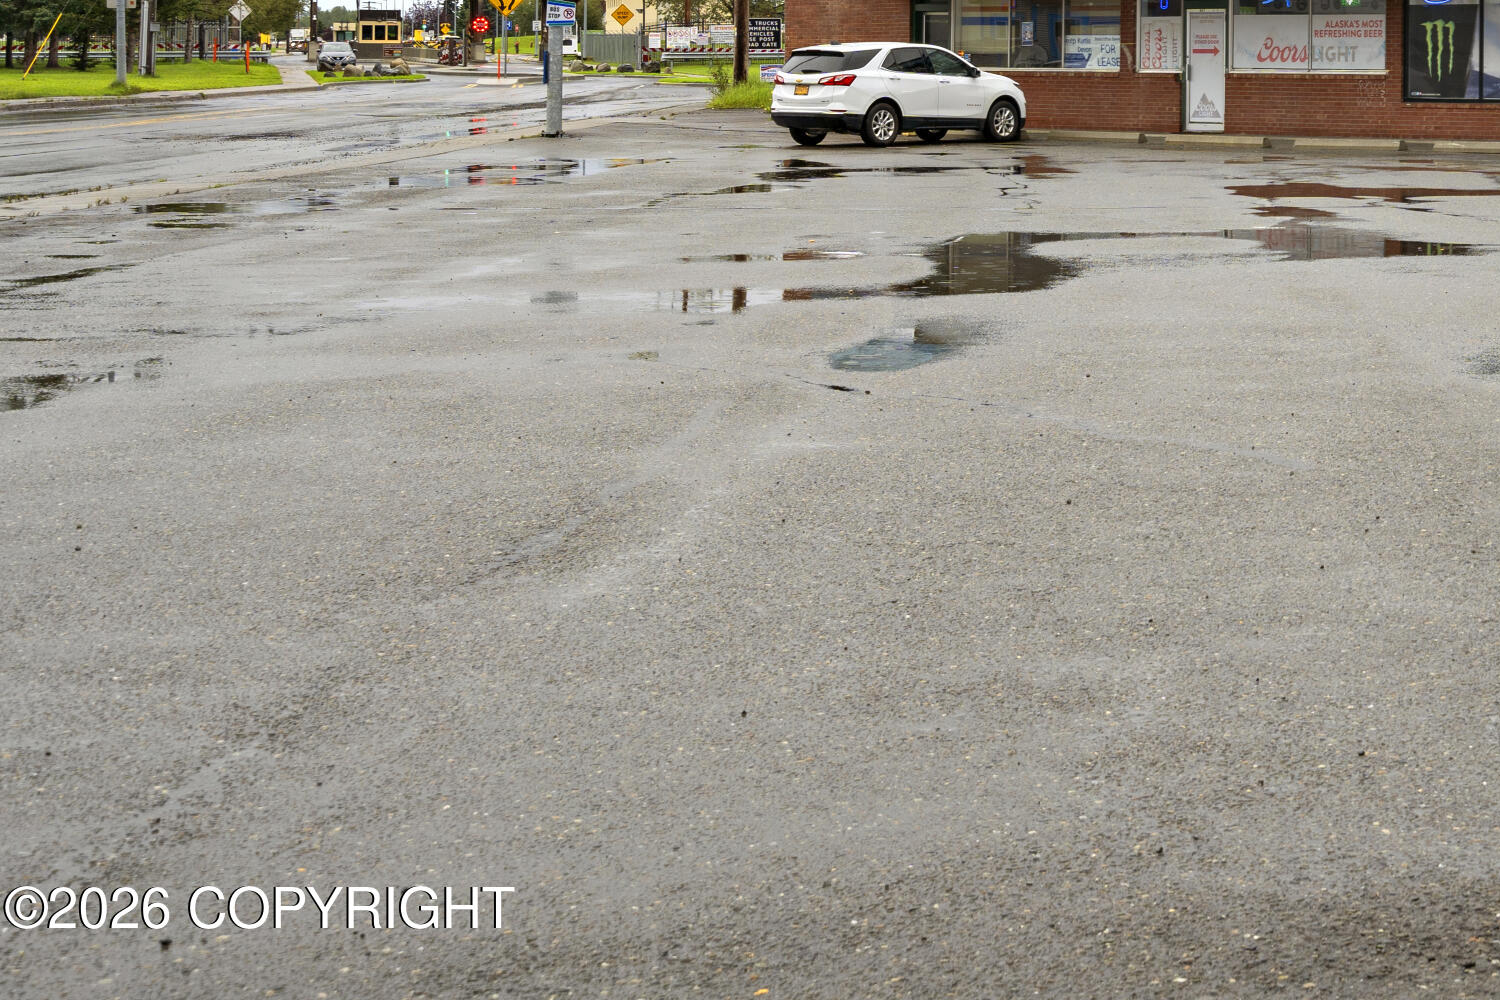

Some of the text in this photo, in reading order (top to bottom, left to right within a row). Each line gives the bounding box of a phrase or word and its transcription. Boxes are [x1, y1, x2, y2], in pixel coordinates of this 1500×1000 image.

[1325, 20, 1383, 28] ALASKA'S MOST
[1314, 30, 1361, 38] REFRESHING
[1101, 44, 1116, 53] FOR
[1152, 27, 1163, 69] Coors
[1256, 37, 1359, 63] Coors LIGHT
[1097, 57, 1120, 67] LEASE
